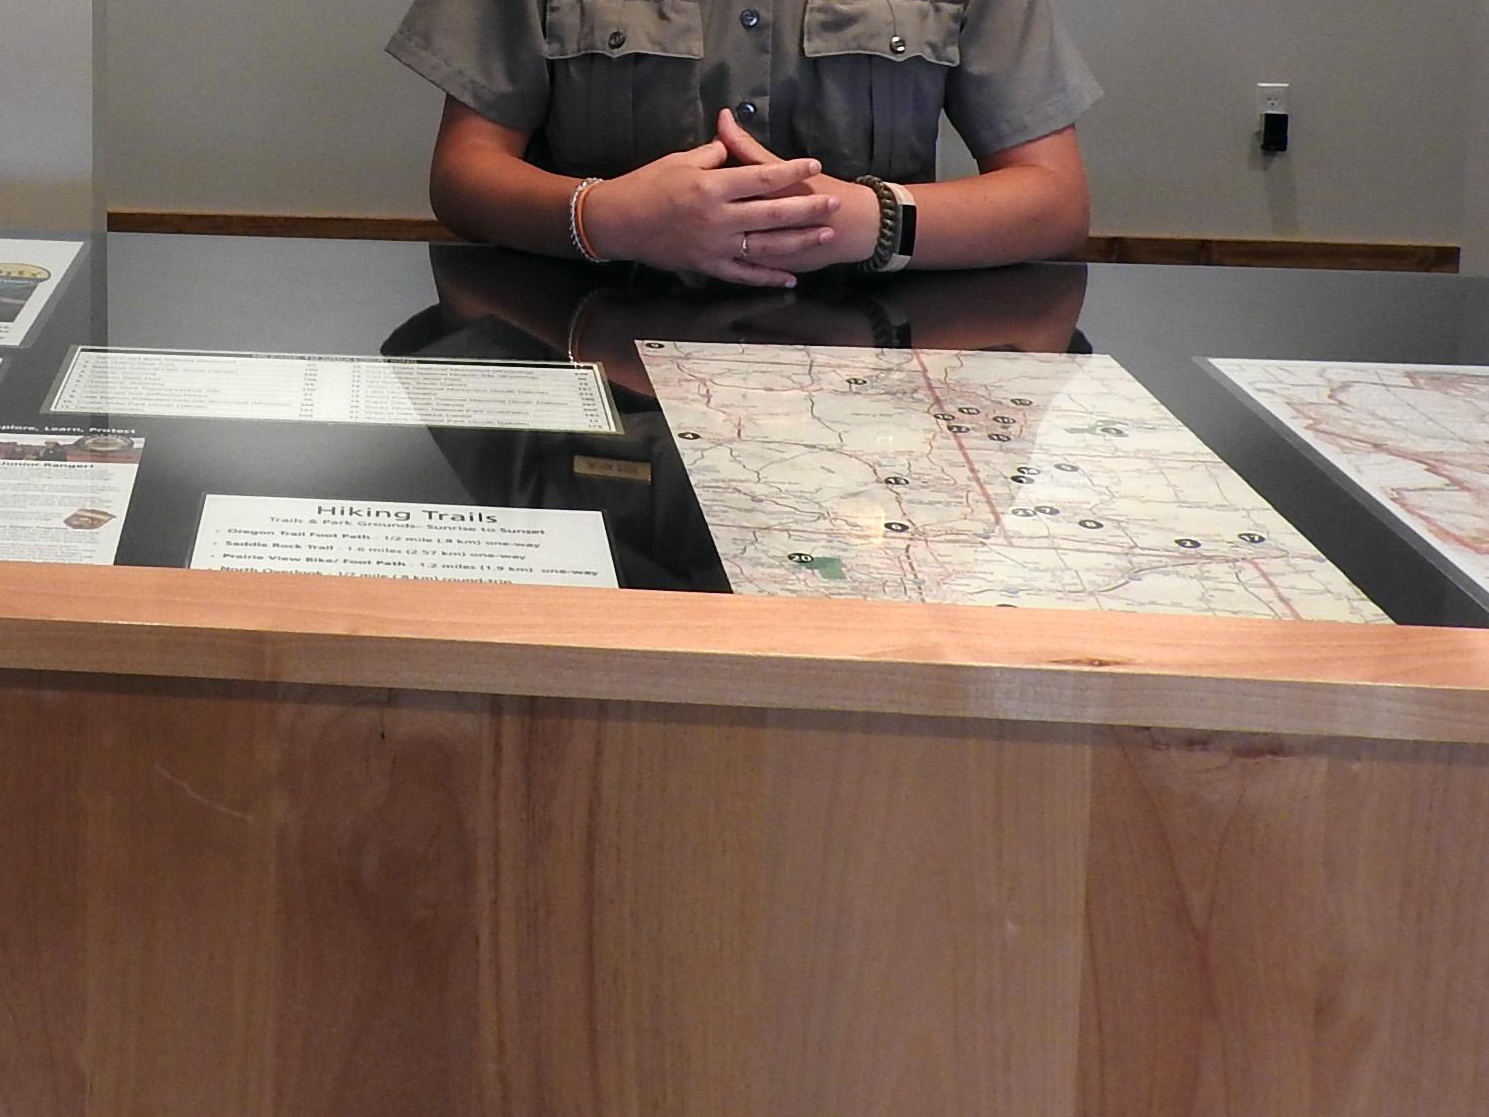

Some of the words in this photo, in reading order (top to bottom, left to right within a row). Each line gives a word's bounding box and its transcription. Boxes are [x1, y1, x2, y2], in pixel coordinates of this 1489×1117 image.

[44, 425, 84, 433] Learn,
[89, 426, 136, 434] Protect
[317, 505, 411, 522] Hiking
[421, 509, 498, 524] Trails
[270, 516, 303, 524] Trails
[426, 524, 477, 532] Sunrise
[499, 527, 545, 535] Sunset
[227, 528, 275, 536] Oregon
[791, 554, 812, 562] 20
[508, 565, 533, 573] km)
[541, 568, 598, 577] one-way
